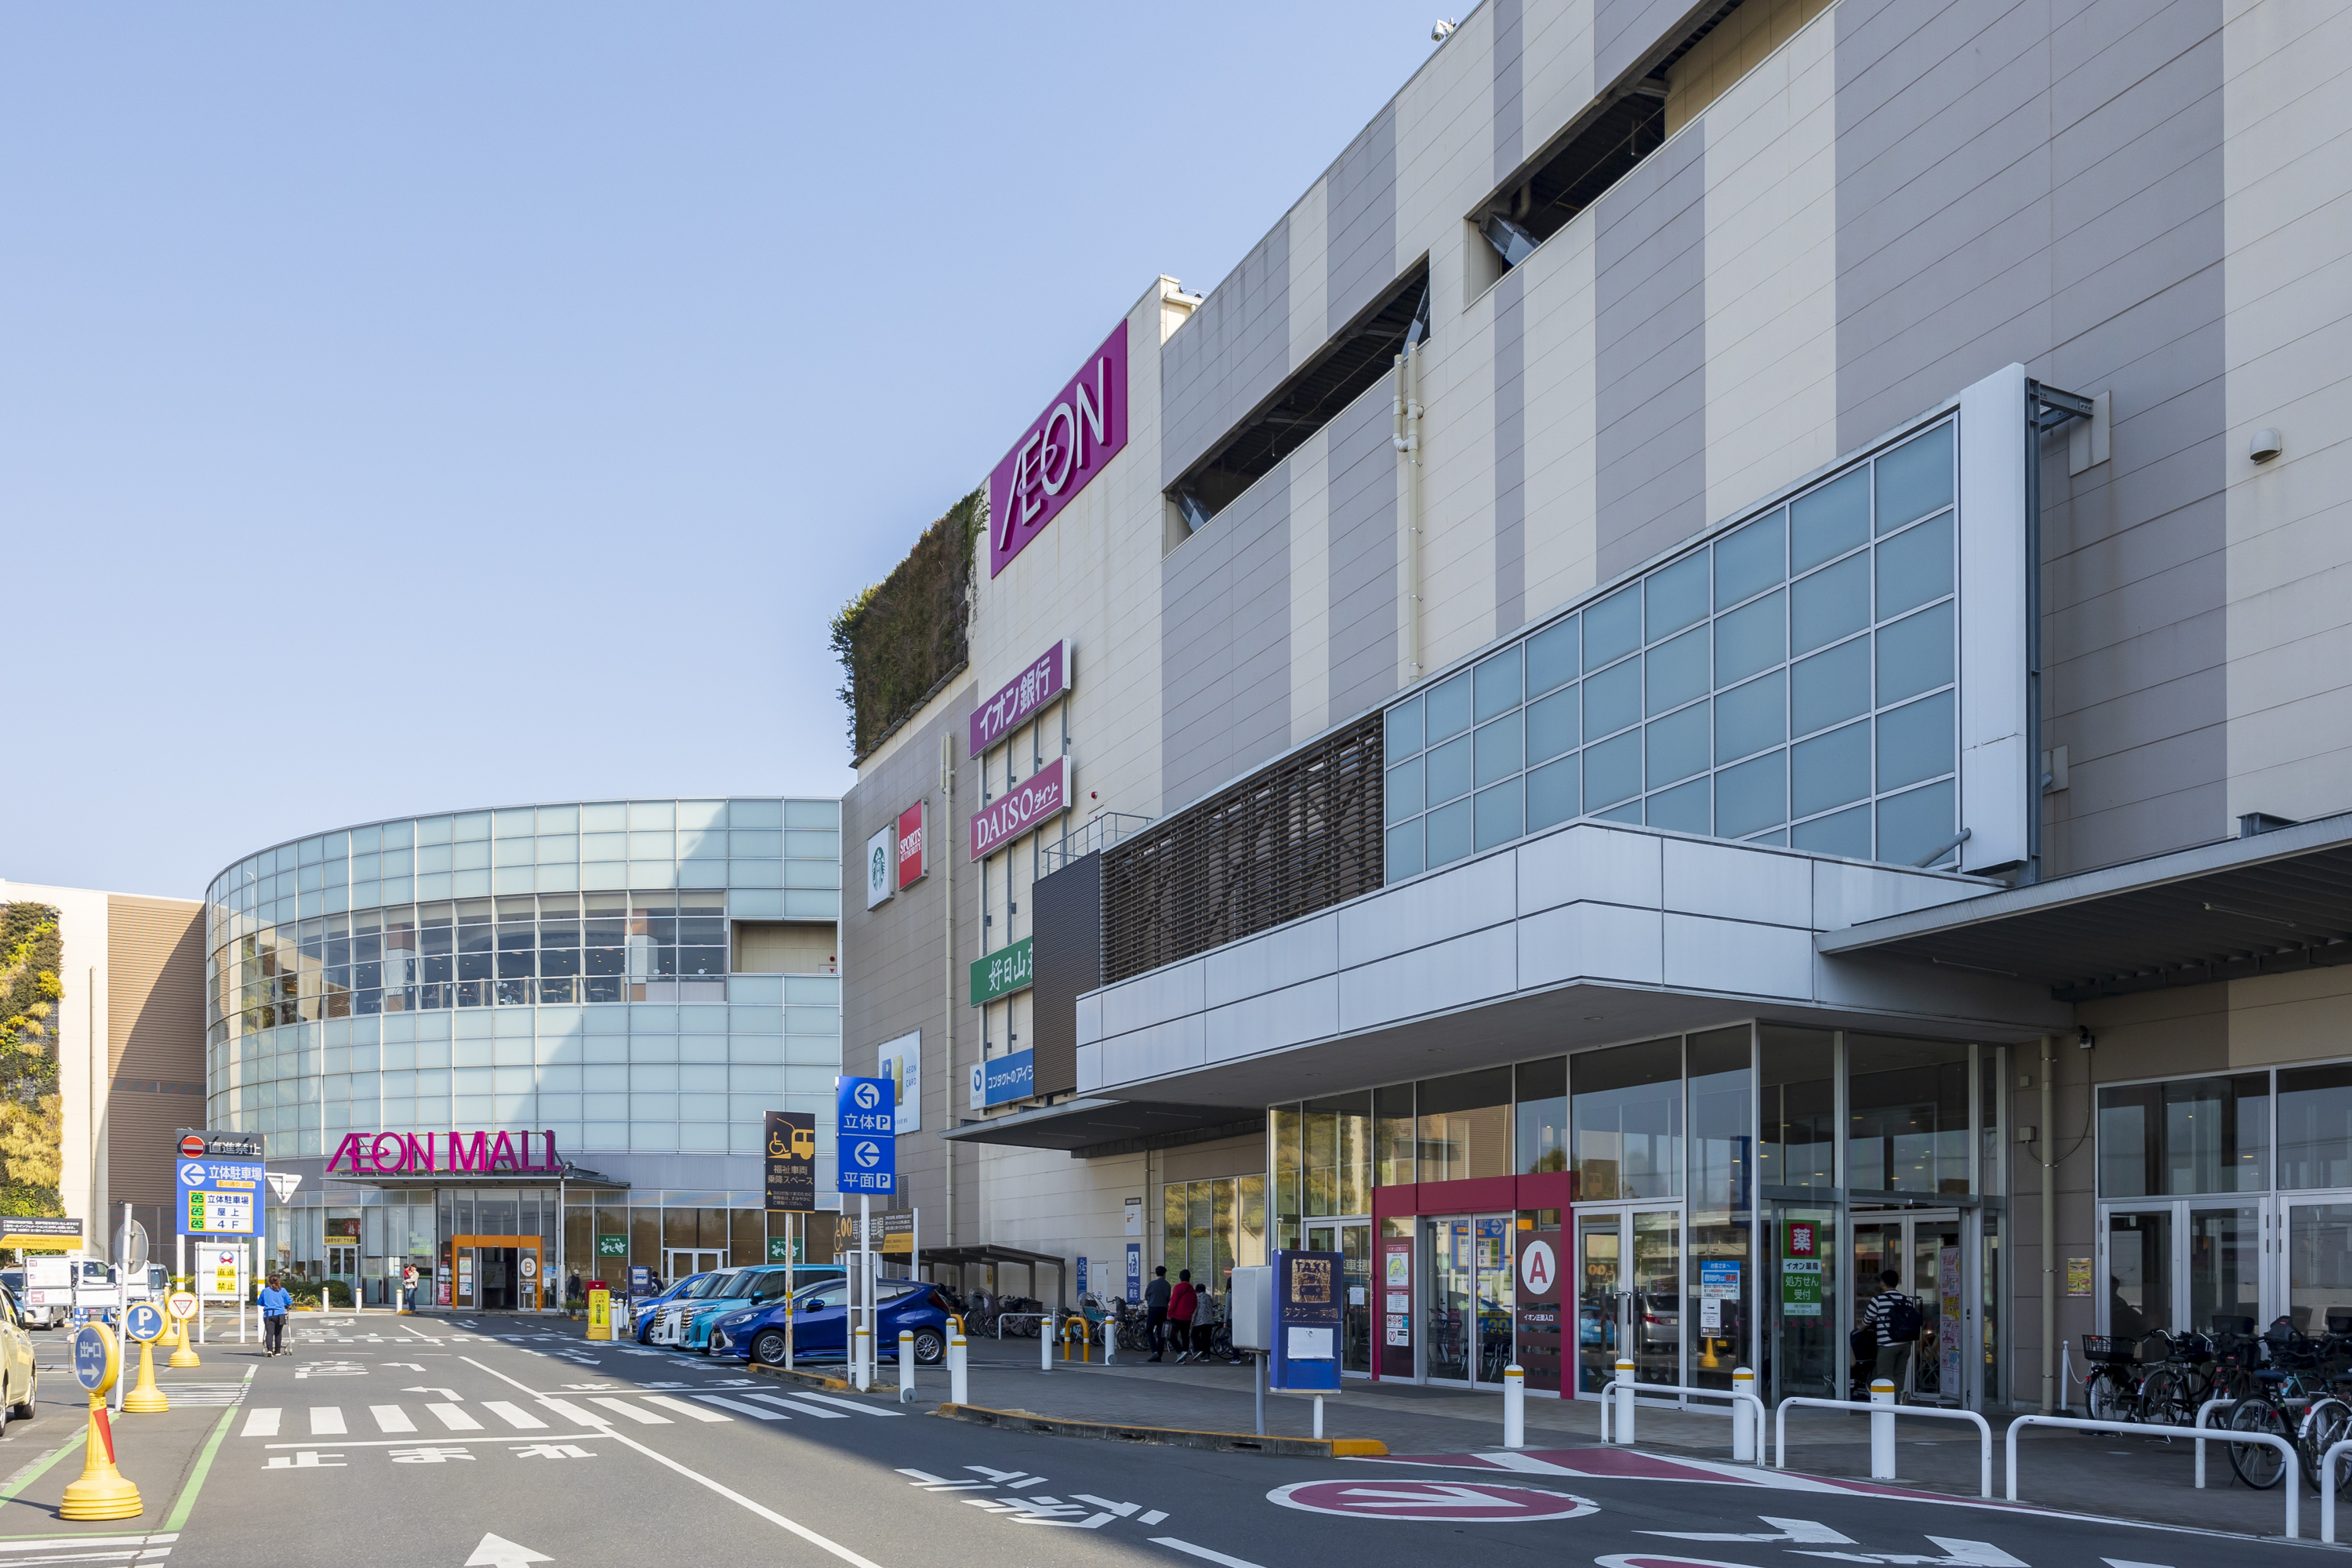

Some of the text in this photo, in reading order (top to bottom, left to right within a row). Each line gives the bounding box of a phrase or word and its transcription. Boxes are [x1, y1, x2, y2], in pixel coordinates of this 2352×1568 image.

[980, 656, 1051, 741] イオン銀行
[977, 788, 1033, 850] DAISO
[900, 827, 921, 855] SPORTS
[900, 841, 921, 863] AUTHORITY
[906, 1064, 916, 1075] AEON
[906, 1077, 916, 1087] CARD
[208, 1142, 261, 1156] 直進禁止
[448, 1129, 563, 1171] MALL
[209, 1165, 262, 1181] 立体駐車場
[774, 1164, 808, 1175] 福祉車両
[768, 1175, 813, 1185] 乗降スペース
[208, 1195, 249, 1205] 立体駐車場
[852, 1217, 884, 1240] 専車場
[1793, 1229, 1811, 1251] 薬
[217, 1268, 235, 1276] 直進
[524, 1261, 532, 1272] B
[1296, 1261, 1327, 1273] TAXI
[1529, 1251, 1548, 1283] A
[217, 1282, 235, 1290] 禁止
[1785, 1276, 1819, 1287] 処方せん
[1794, 1289, 1810, 1301] 受付
[138, 1308, 153, 1327] P
[80, 1341, 101, 1358] 出口
